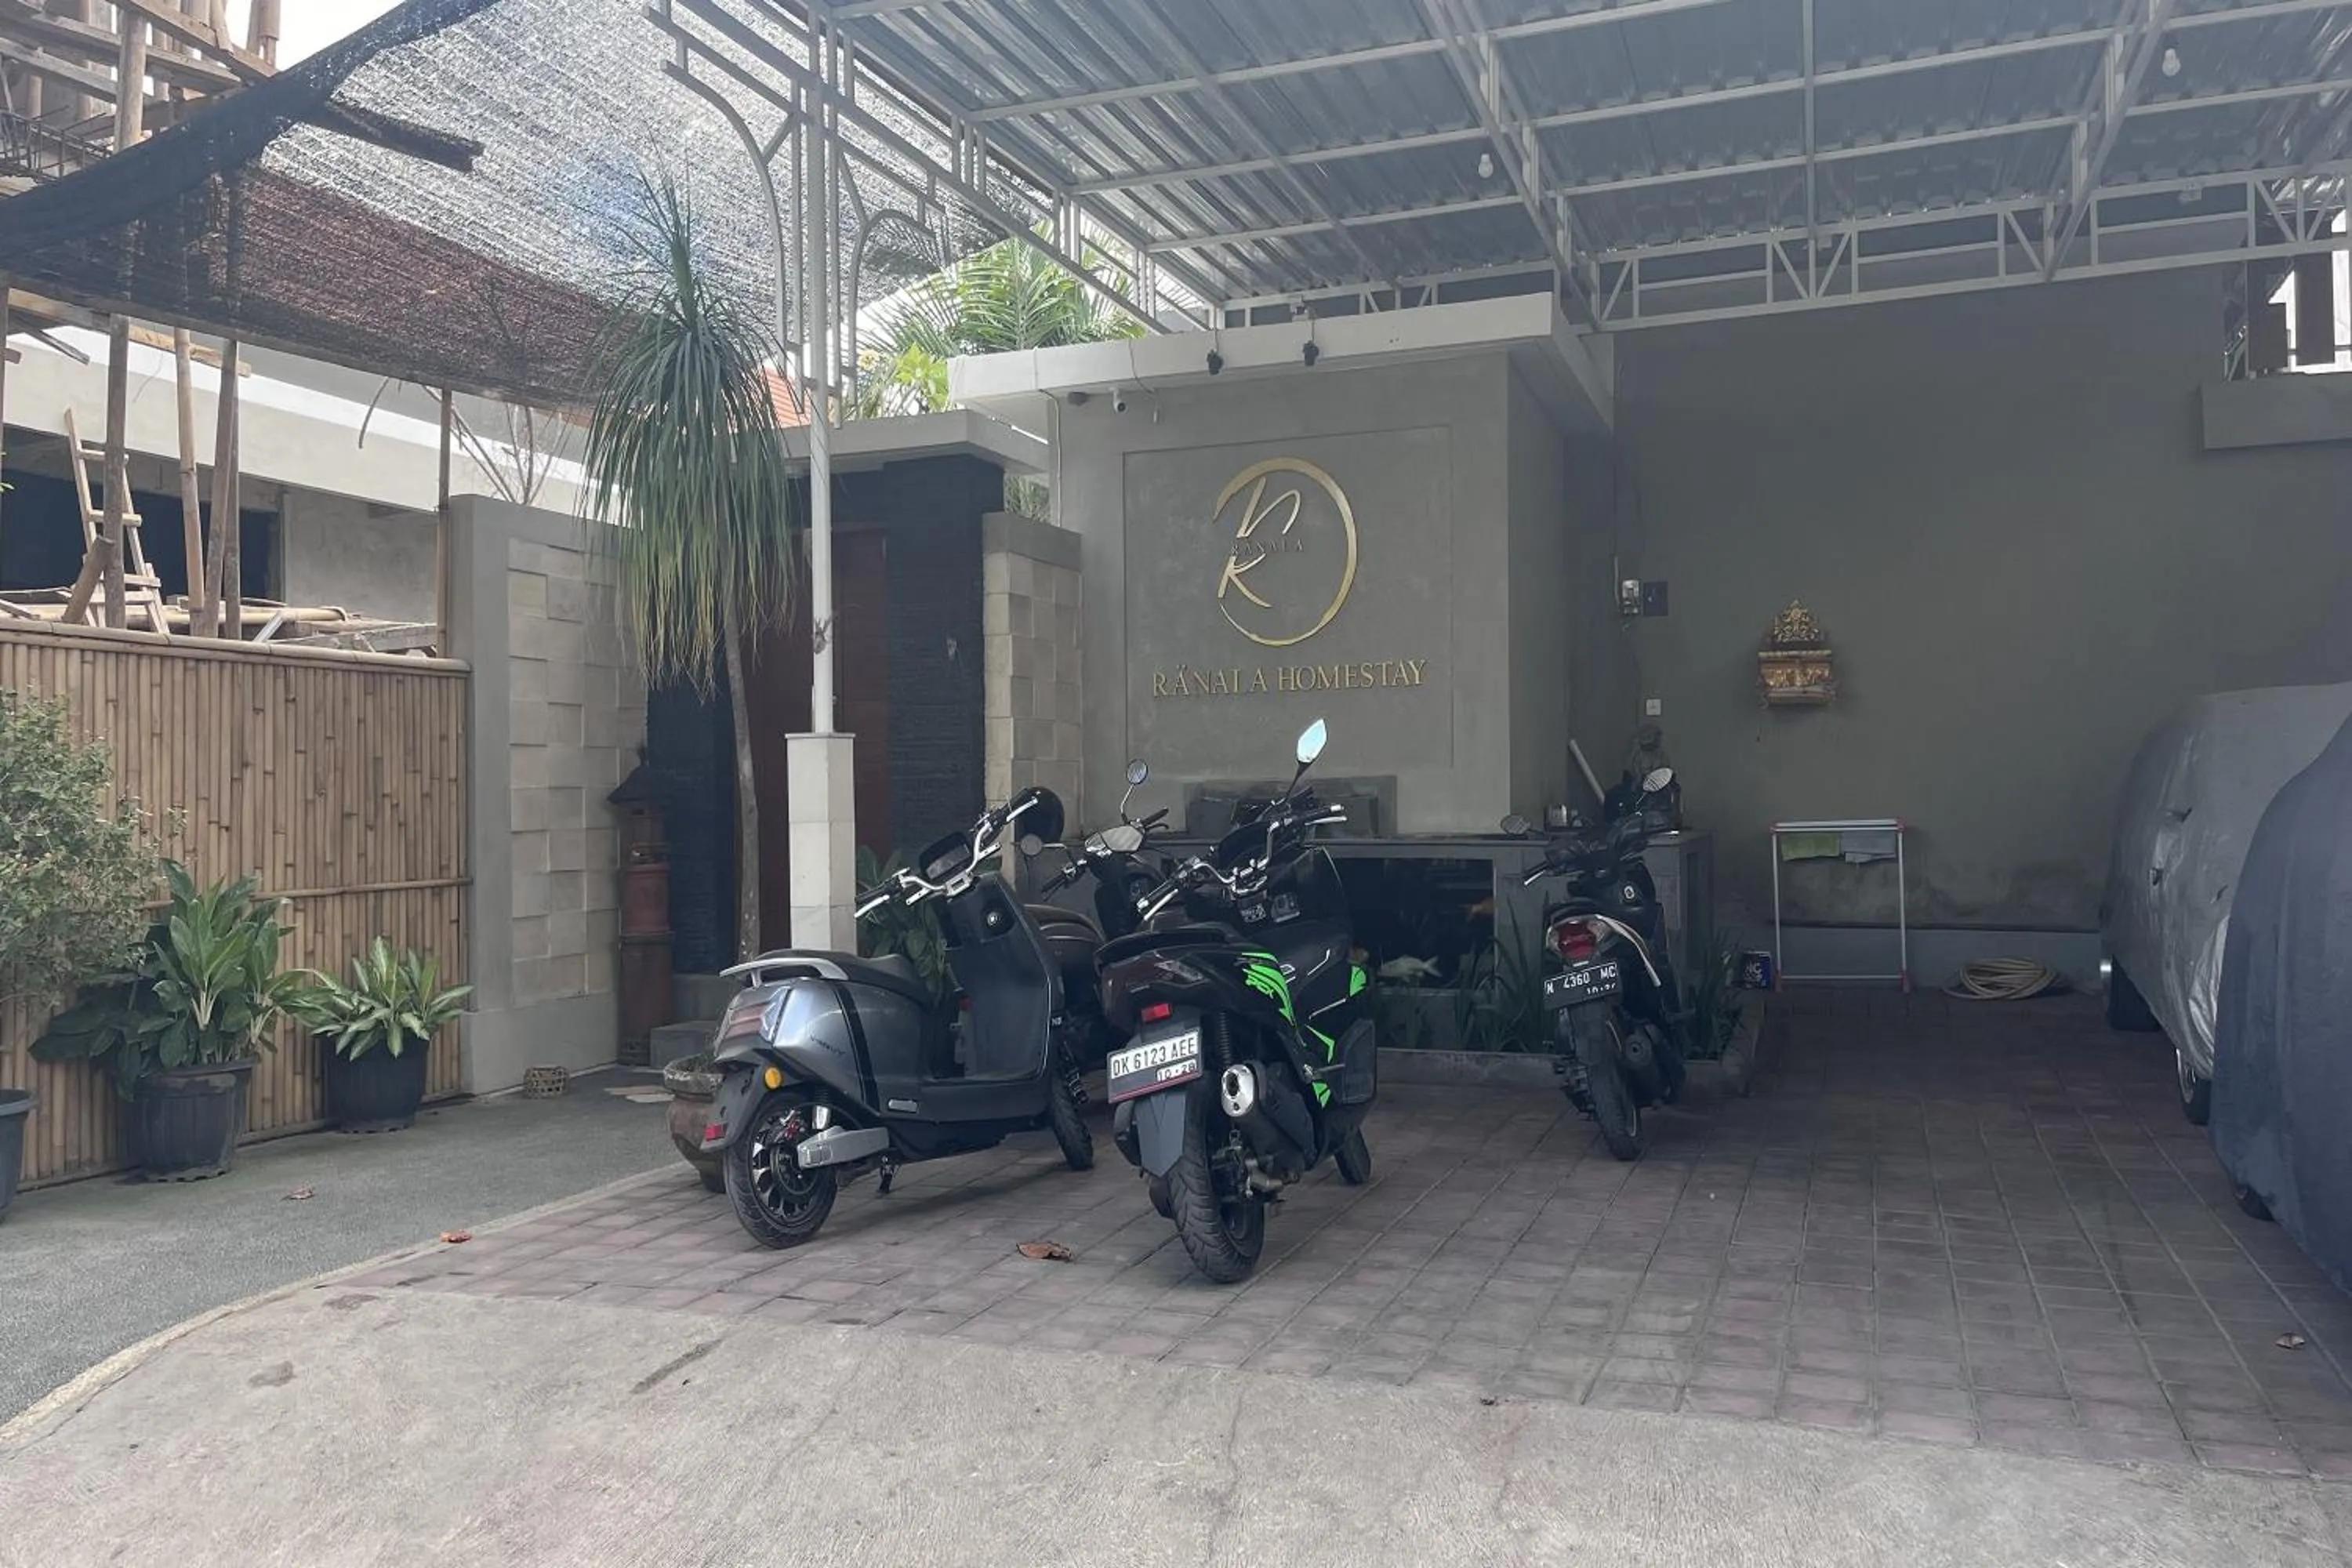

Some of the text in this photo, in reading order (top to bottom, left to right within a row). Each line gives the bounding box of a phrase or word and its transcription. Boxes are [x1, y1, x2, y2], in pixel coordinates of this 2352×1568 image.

[1277, 659, 1427, 692] HOMESTAY
[1563, 971, 1591, 989] 4360
[1600, 965, 1617, 979] MC
[1112, 1037, 1196, 1076] DK 6123 AEE
